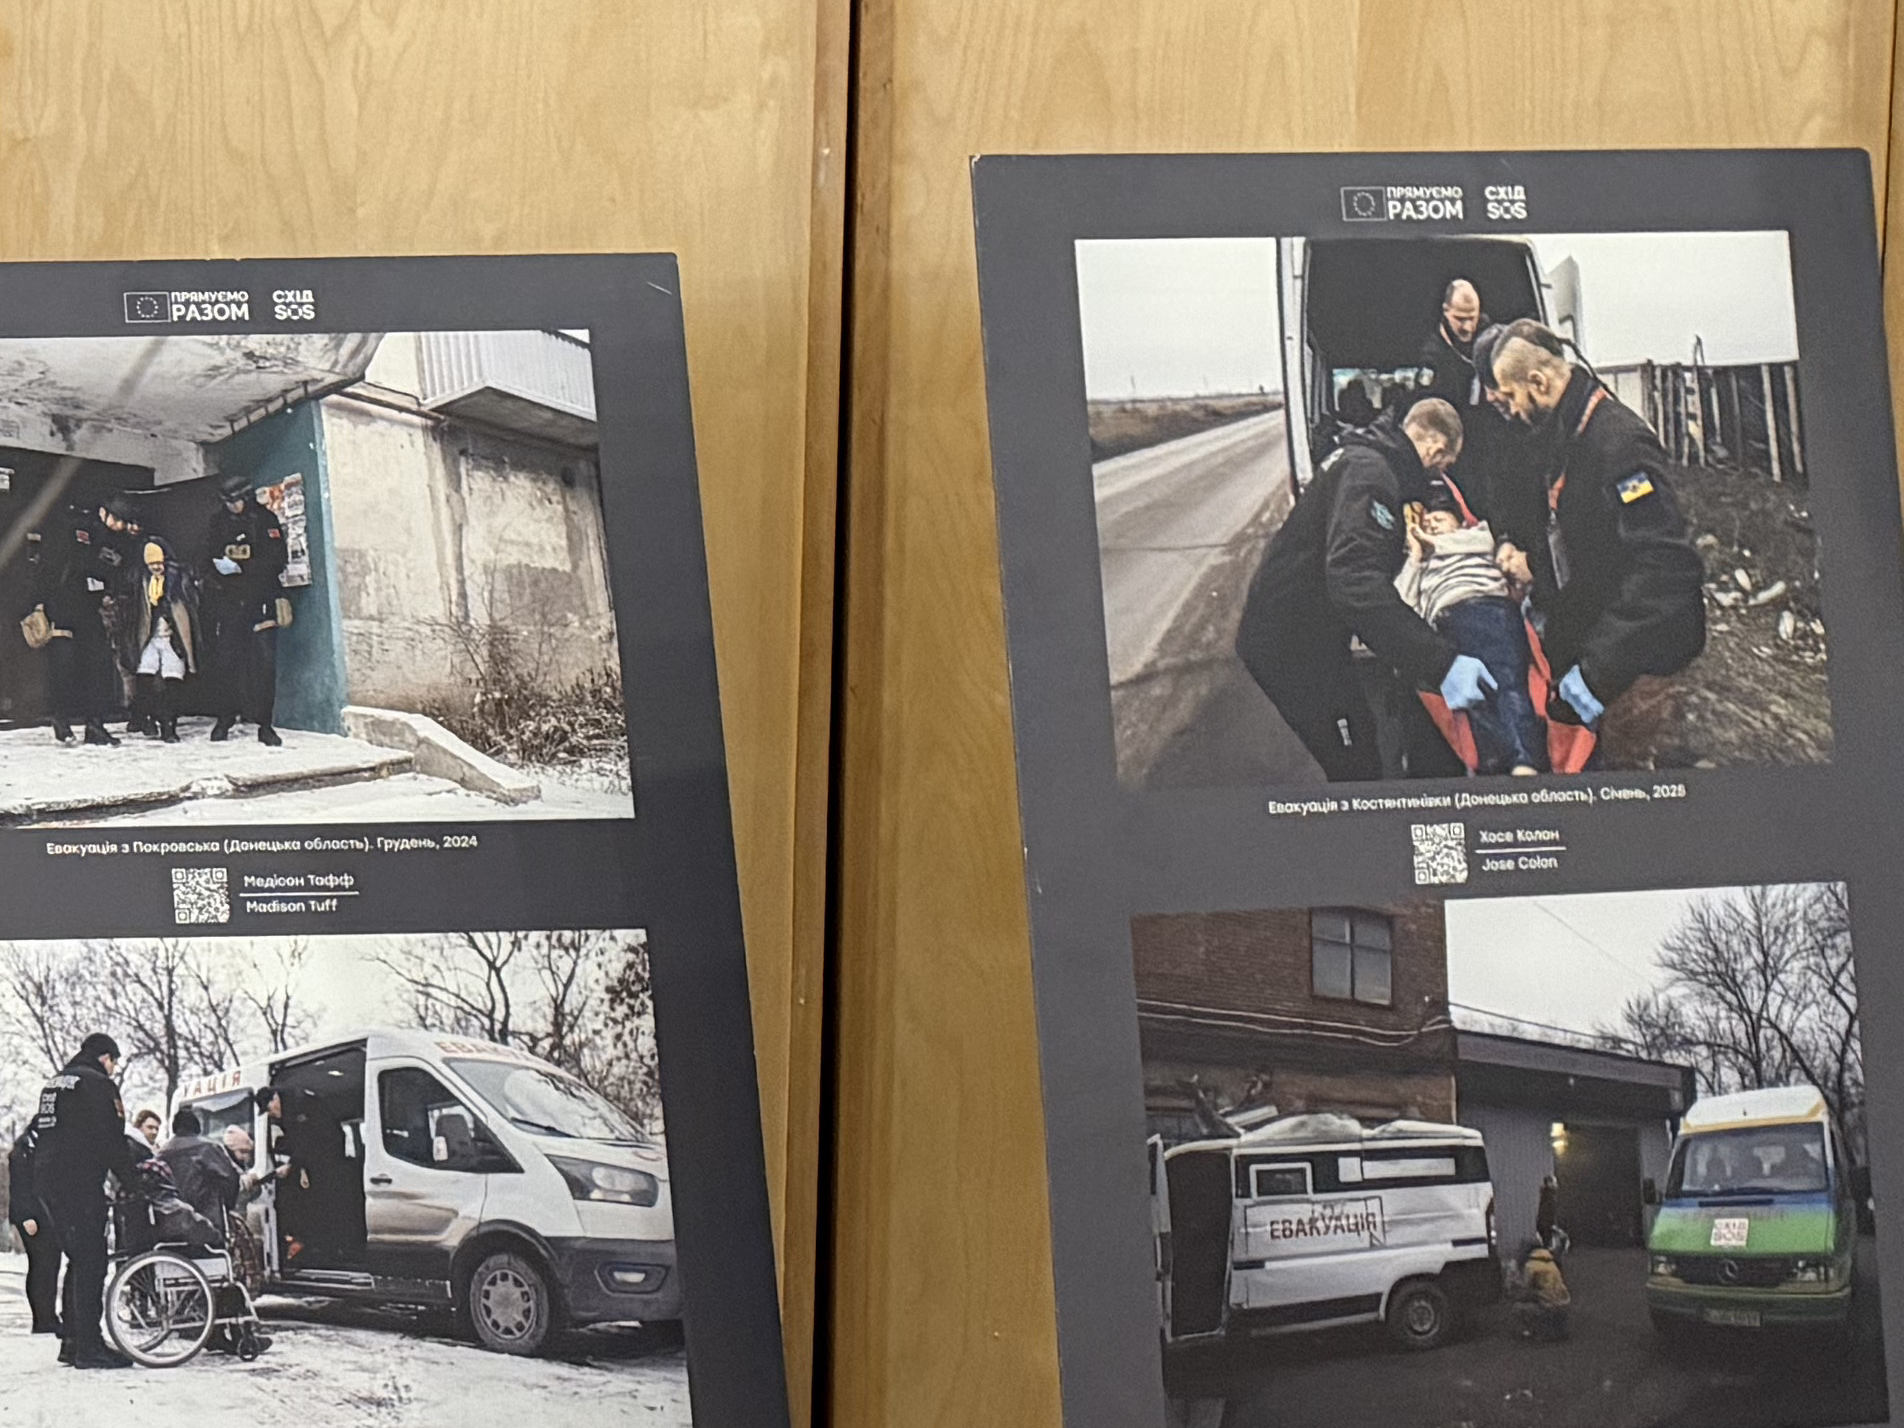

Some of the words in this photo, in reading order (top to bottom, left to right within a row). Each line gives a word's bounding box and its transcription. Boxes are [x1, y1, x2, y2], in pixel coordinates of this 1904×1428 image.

[1387, 186, 1463, 199] ПРЯМУЄМО
[1484, 185, 1526, 200] СХІД
[1388, 200, 1463, 220] РАЗОМ
[1487, 201, 1527, 219] SOS
[171, 291, 249, 303] ПРЯМУЄМО
[272, 290, 314, 303] СХІД
[172, 303, 249, 321] РАЗОМ
[274, 303, 315, 320] SOS
[1479, 830, 1513, 843] Хосе
[1516, 829, 1559, 841] Колон
[46, 840, 117, 857] Евакуація
[132, 841, 220, 855] Покровська
[223, 838, 300, 854] (Донецька
[304, 836, 373, 852] область).
[376, 836, 439, 852] Грудень,
[442, 835, 477, 847] 2024
[1481, 858, 1515, 871] Jose
[1517, 855, 1558, 869] Colon
[243, 873, 304, 888] Медісон
[307, 872, 354, 888] Тафф
[246, 899, 305, 912] Madison
[308, 898, 337, 911] Tuff
[1269, 1212, 1377, 1240] ЕВАКУАЦІЯ
